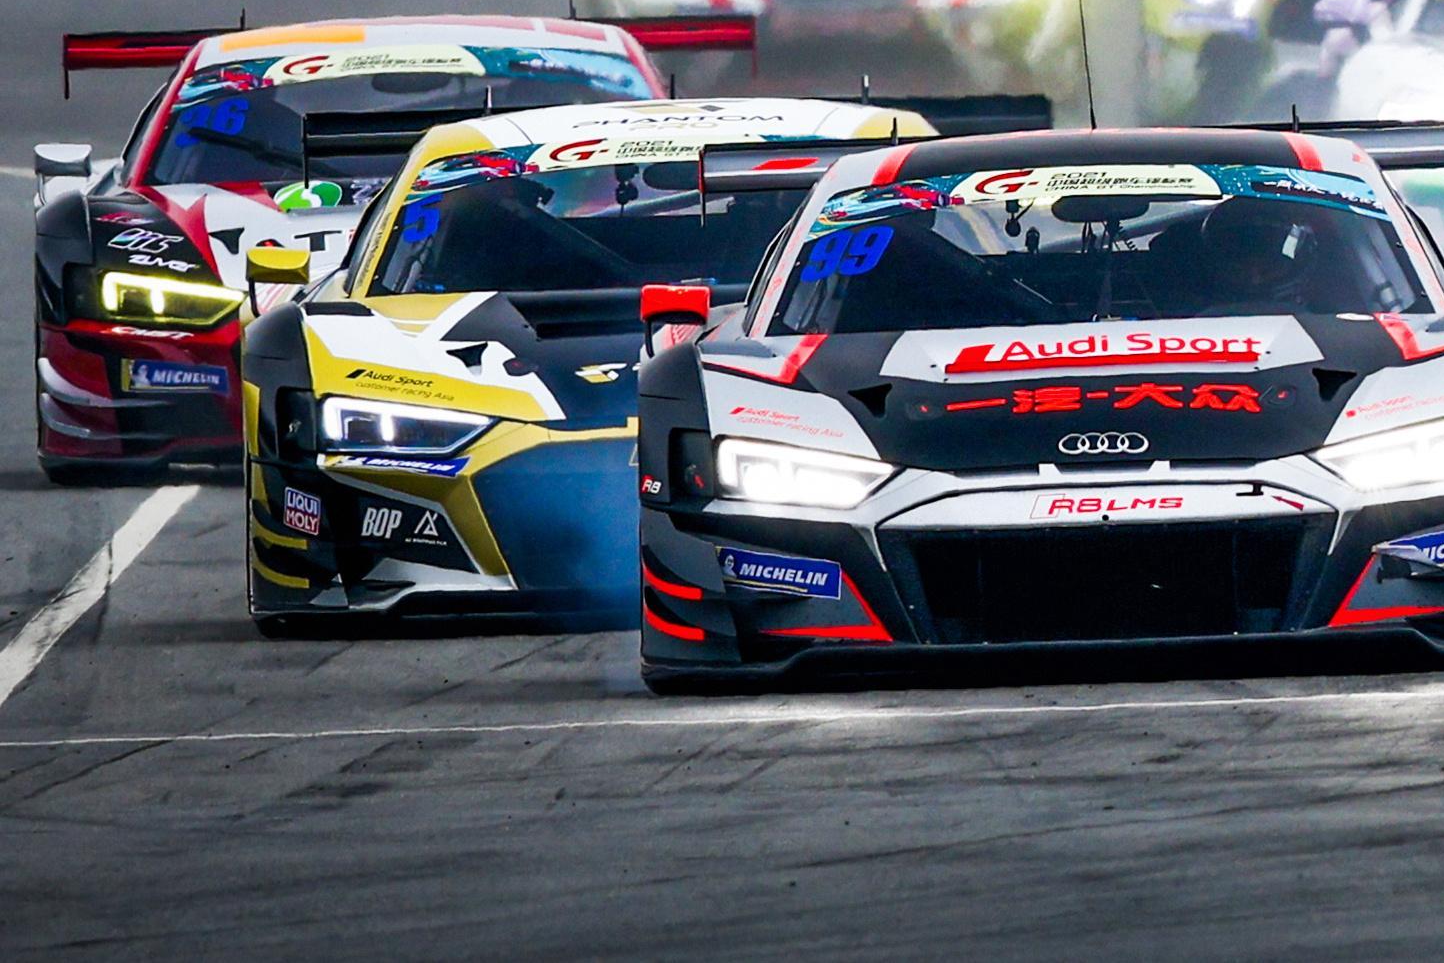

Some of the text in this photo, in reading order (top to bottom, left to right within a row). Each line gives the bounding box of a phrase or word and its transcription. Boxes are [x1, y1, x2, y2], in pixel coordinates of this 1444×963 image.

[573, 114, 784, 128] PHANTOM
[402, 193, 444, 243] 5
[801, 225, 894, 282] 99
[1000, 333, 1261, 363] Audi Sport
[152, 369, 220, 384] MICHELIN
[365, 370, 434, 387] Audi Sport
[355, 381, 455, 402] customer racing Asia
[946, 382, 1262, 414] 一汽-大众
[366, 458, 455, 472] MICHELIN
[641, 478, 662, 495] R8
[286, 490, 320, 515] LIQUI
[286, 510, 318, 533] MOLY
[361, 507, 403, 539] BOP
[739, 562, 829, 586] MICHELIN
